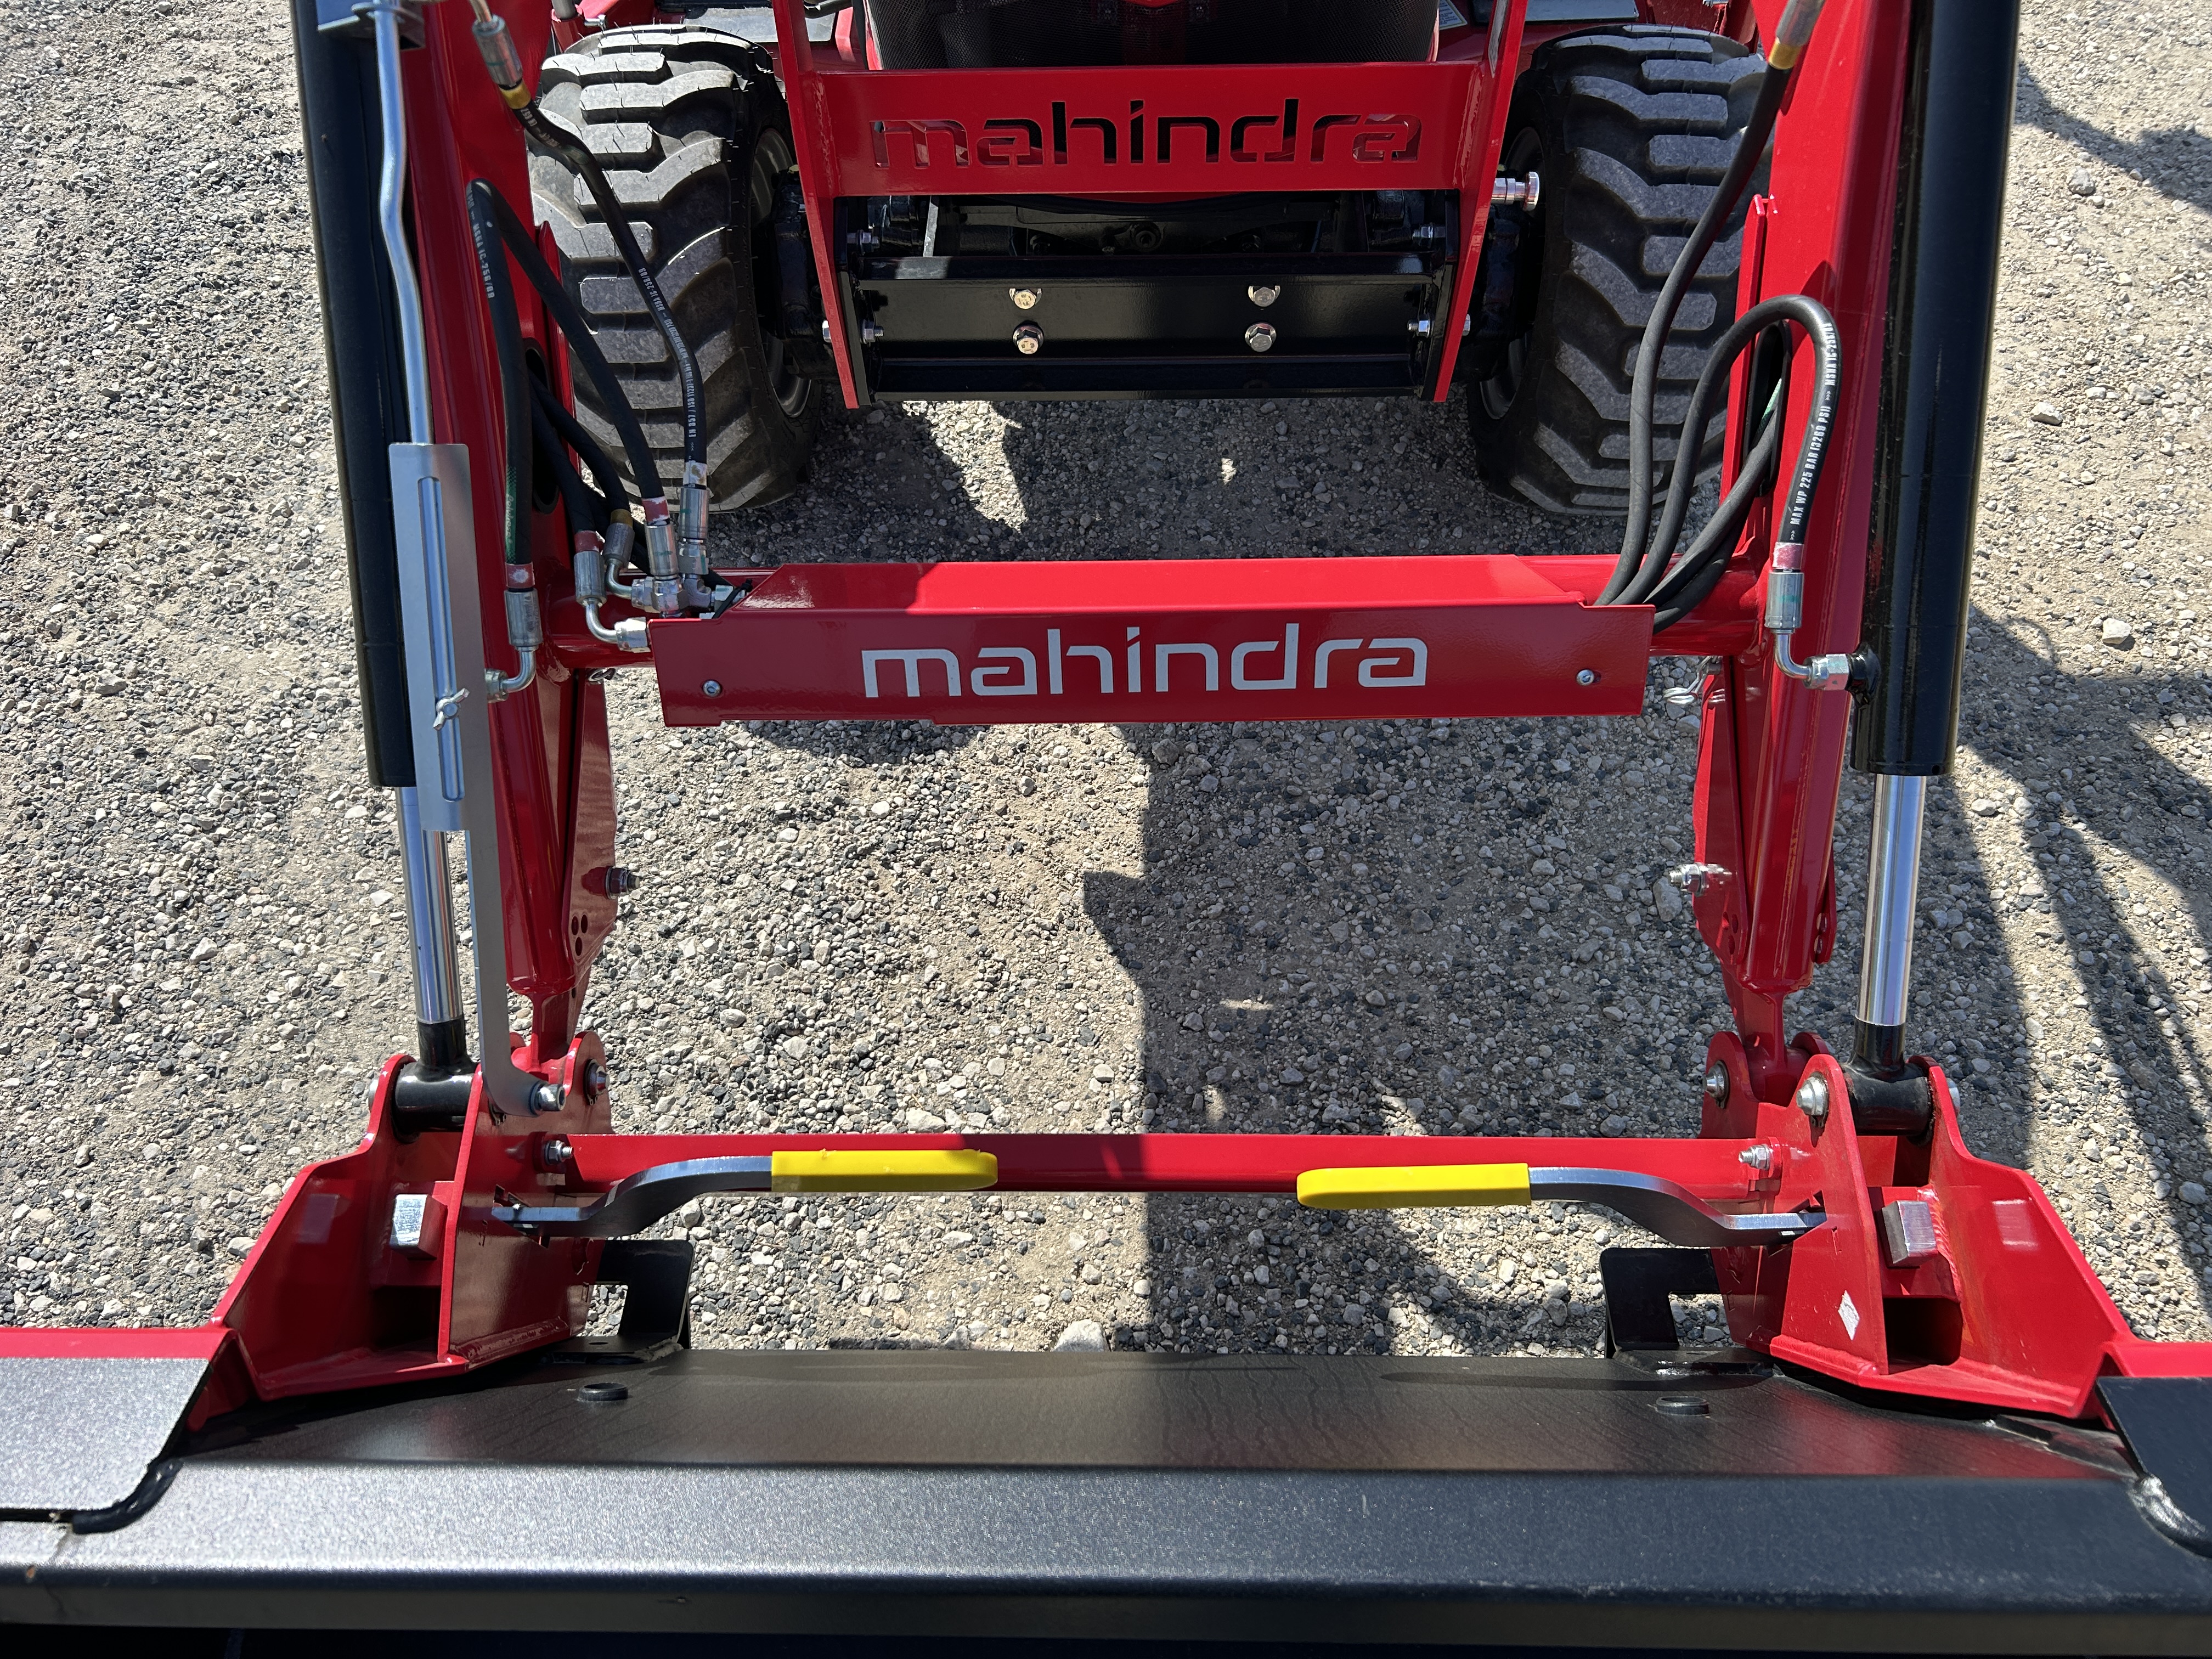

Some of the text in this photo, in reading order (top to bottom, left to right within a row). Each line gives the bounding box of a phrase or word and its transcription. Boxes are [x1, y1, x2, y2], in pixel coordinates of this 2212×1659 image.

[870, 99, 1422, 169] mahindra
[688, 415, 696, 427] 857
[1810, 425, 1827, 451] (3260
[1805, 452, 1819, 470] BAR
[1799, 471, 1813, 488] 225
[1796, 490, 1807, 504] WP
[1790, 506, 1804, 525] MAX
[861, 623, 1428, 698] mahindra
